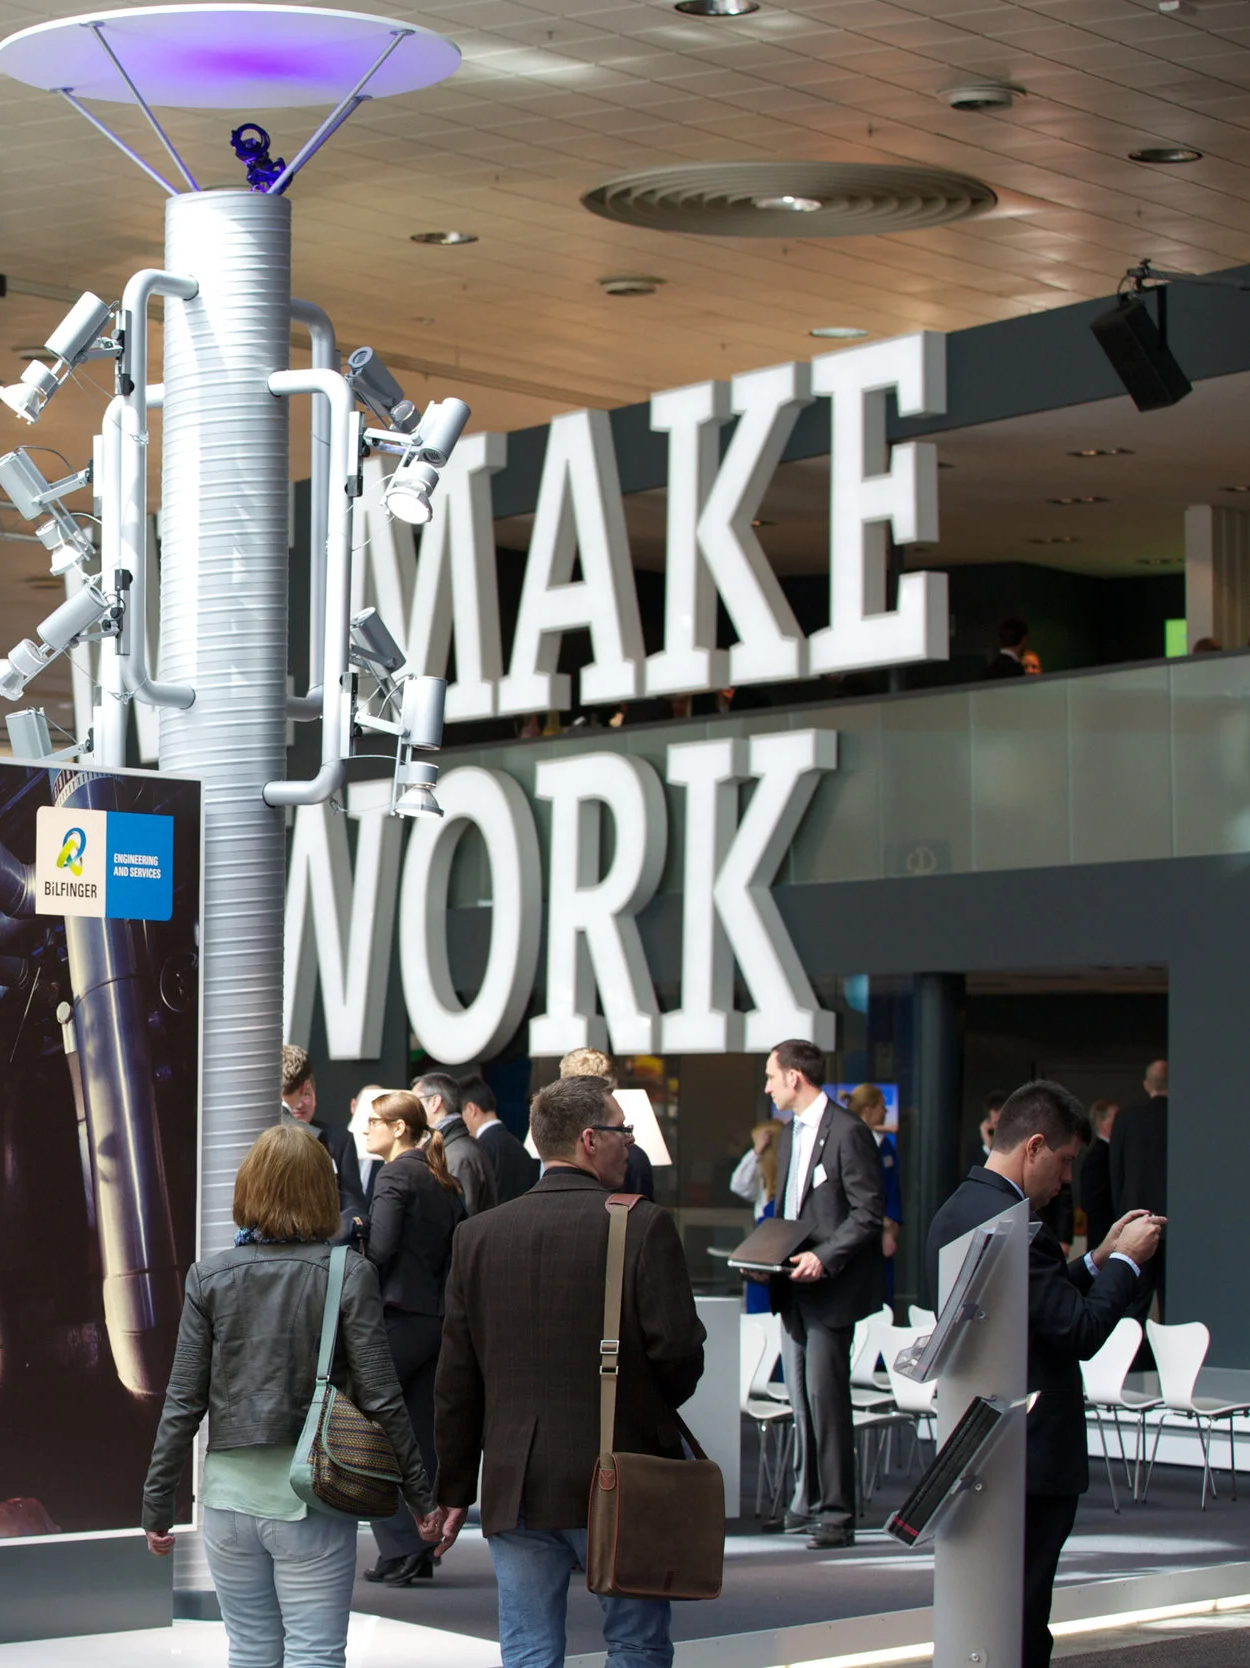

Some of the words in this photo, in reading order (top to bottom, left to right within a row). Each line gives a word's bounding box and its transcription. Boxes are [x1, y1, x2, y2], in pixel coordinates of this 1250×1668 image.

[350, 330, 948, 723] MAKE
[113, 853, 159, 866] ENGINEERING
[113, 866, 129, 877] AND
[129, 868, 162, 879] SERVICES
[283, 728, 838, 1065] WORK
